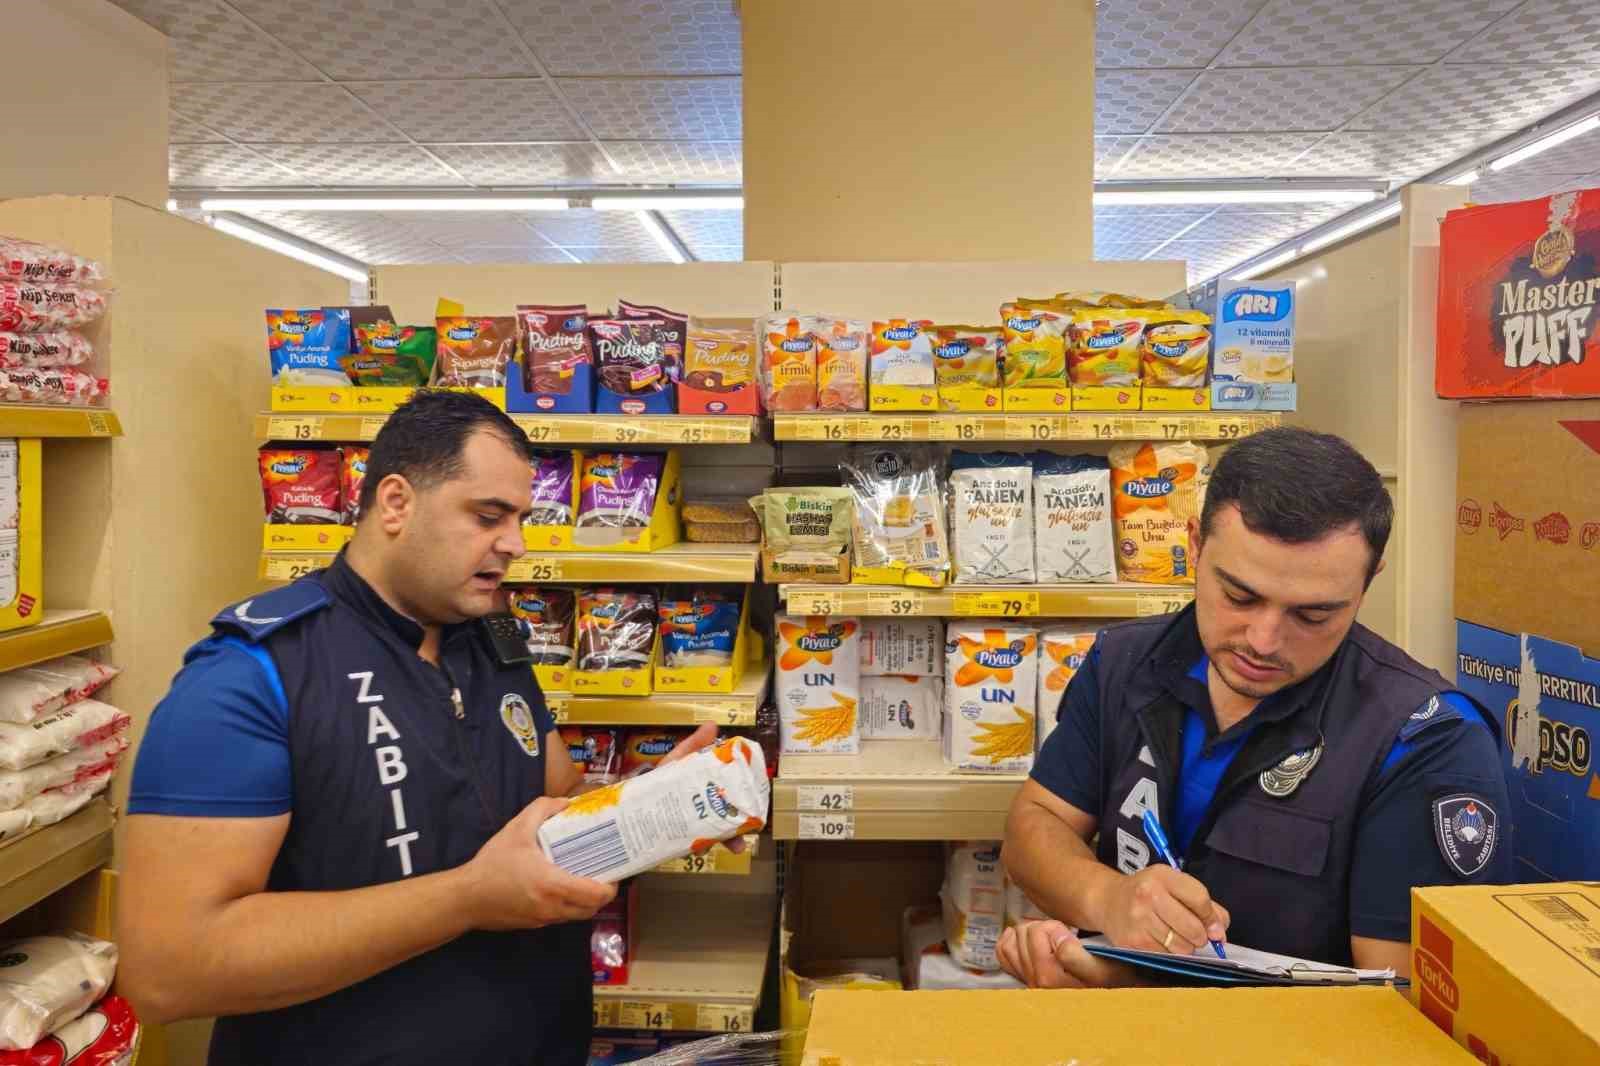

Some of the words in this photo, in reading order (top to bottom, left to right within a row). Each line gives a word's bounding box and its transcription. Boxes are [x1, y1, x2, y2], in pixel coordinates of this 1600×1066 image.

[1499, 275, 1600, 316] Master
[1236, 294, 1277, 317] ARI
[1237, 328, 1249, 338] 12
[1503, 307, 1593, 368] PUFF
[529, 331, 584, 352] Puding
[599, 339, 658, 361] Puding
[289, 352, 329, 367] Puding
[695, 349, 750, 367] Puding
[294, 425, 311, 439] 13
[529, 427, 549, 440] 47
[615, 428, 637, 440] 39
[681, 429, 700, 441] 45
[824, 425, 842, 440] 16
[881, 425, 901, 440] 23
[956, 425, 974, 439] 18
[1031, 425, 1049, 440] 10
[1093, 424, 1113, 439] 14
[1162, 424, 1179, 439] 17
[1218, 424, 1240, 438] 59
[972, 479, 1018, 488] Anadolu
[1127, 479, 1171, 497] Piyale
[283, 493, 322, 507] Puding
[965, 489, 1025, 504] TANEM
[1044, 492, 1105, 511] TANEM
[800, 499, 833, 512] Biskin
[1121, 520, 1144, 531] Tam
[1142, 531, 1166, 542] Unu
[532, 565, 553, 580] 25
[811, 600, 832, 615] 53
[891, 599, 913, 614] 39
[1002, 600, 1023, 615] 79
[801, 635, 839, 650] Piyale
[979, 650, 1019, 666] Piyale
[803, 673, 836, 687] UN
[981, 687, 1016, 703] UN
[691, 793, 709, 821] UN
[820, 793, 842, 810] 42
[820, 822, 844, 835] 109
[683, 856, 705, 872] 39
[1420, 957, 1455, 1004] Torku
[644, 1010, 663, 1028] 14
[723, 1014, 741, 1031] 16
